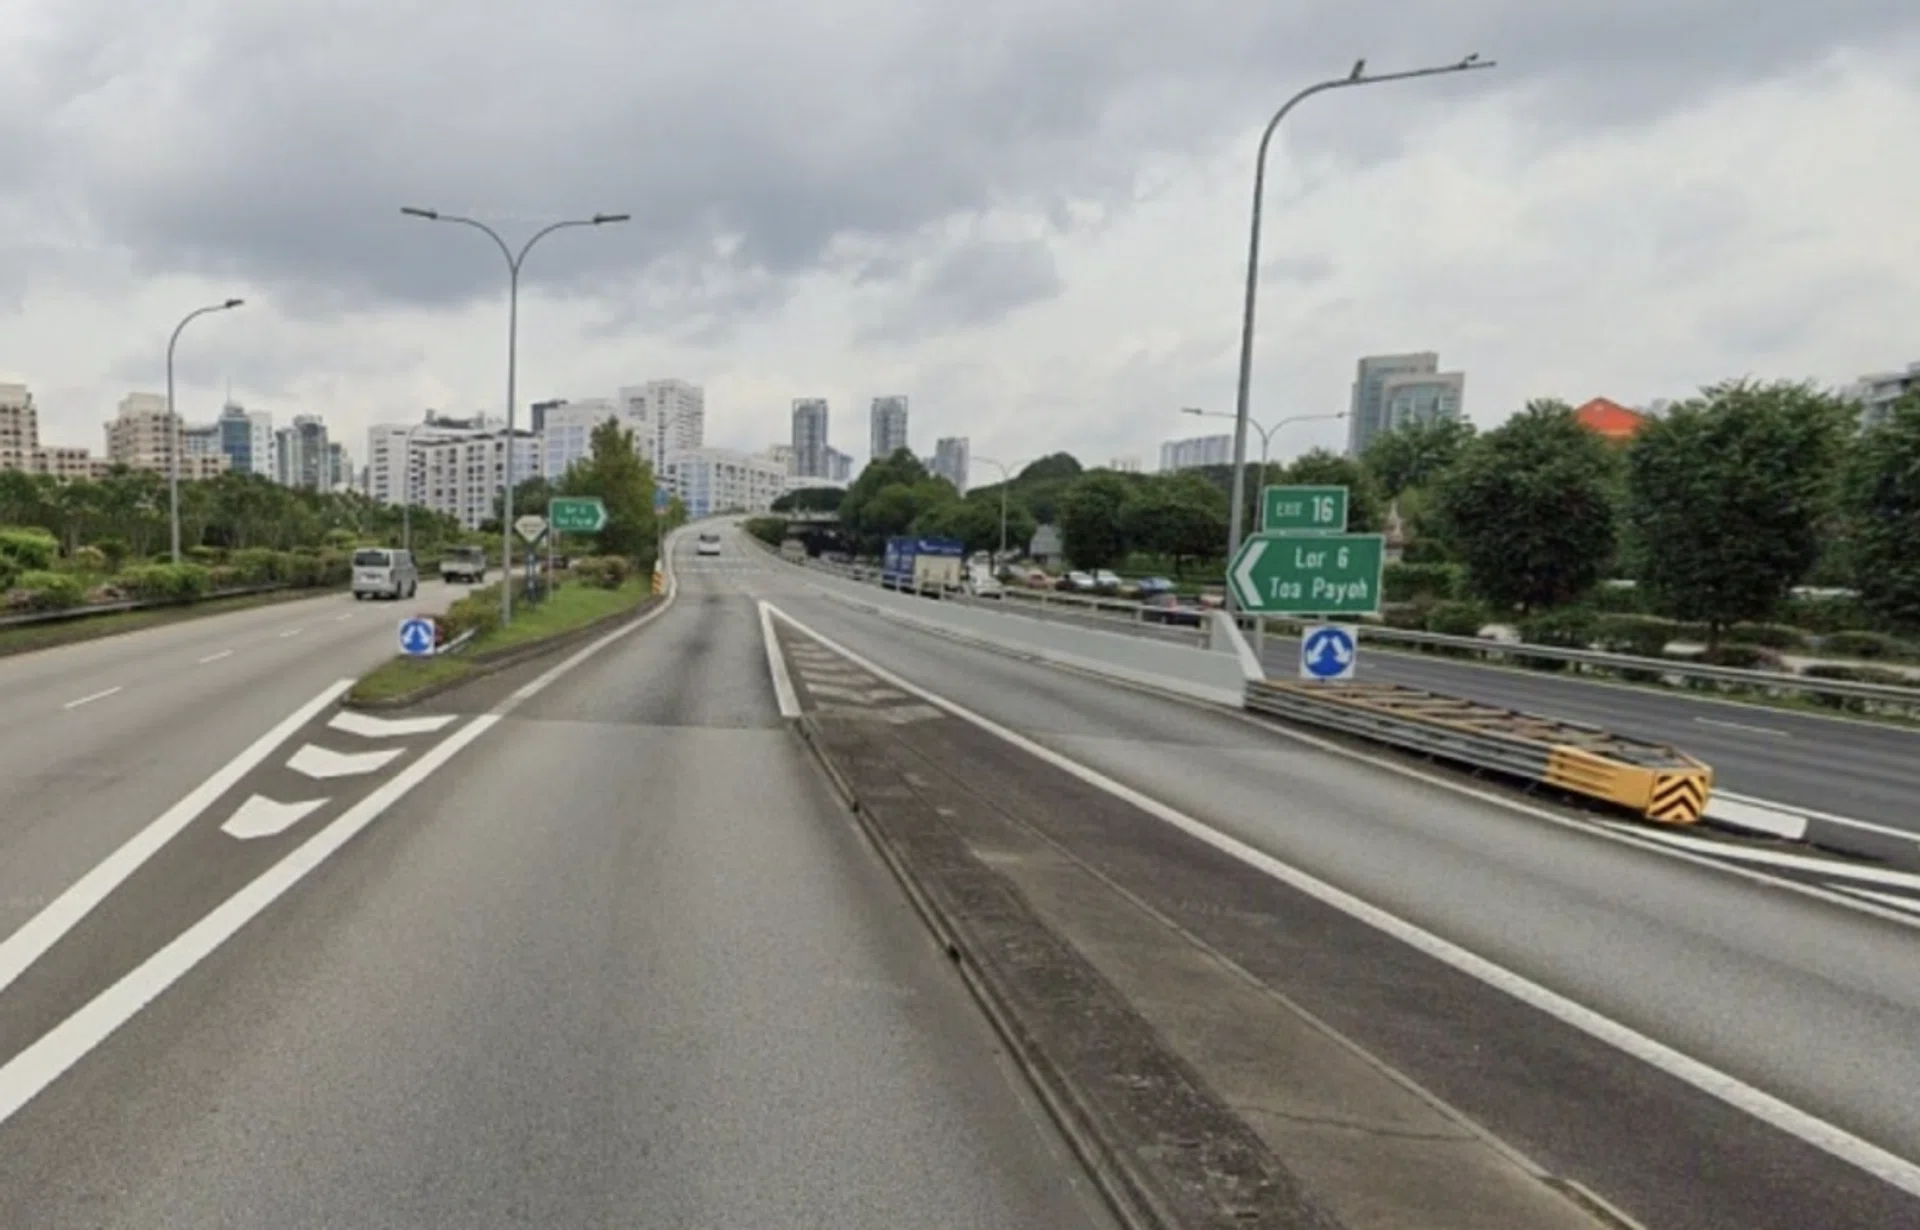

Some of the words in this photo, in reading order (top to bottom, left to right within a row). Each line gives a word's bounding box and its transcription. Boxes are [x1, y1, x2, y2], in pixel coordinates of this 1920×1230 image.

[1312, 496, 1334, 523] 16
[1295, 546, 1326, 568] Lor
[1337, 546, 1349, 568] 6
[1269, 576, 1302, 598] Toa
[1312, 576, 1367, 604] Payoh
